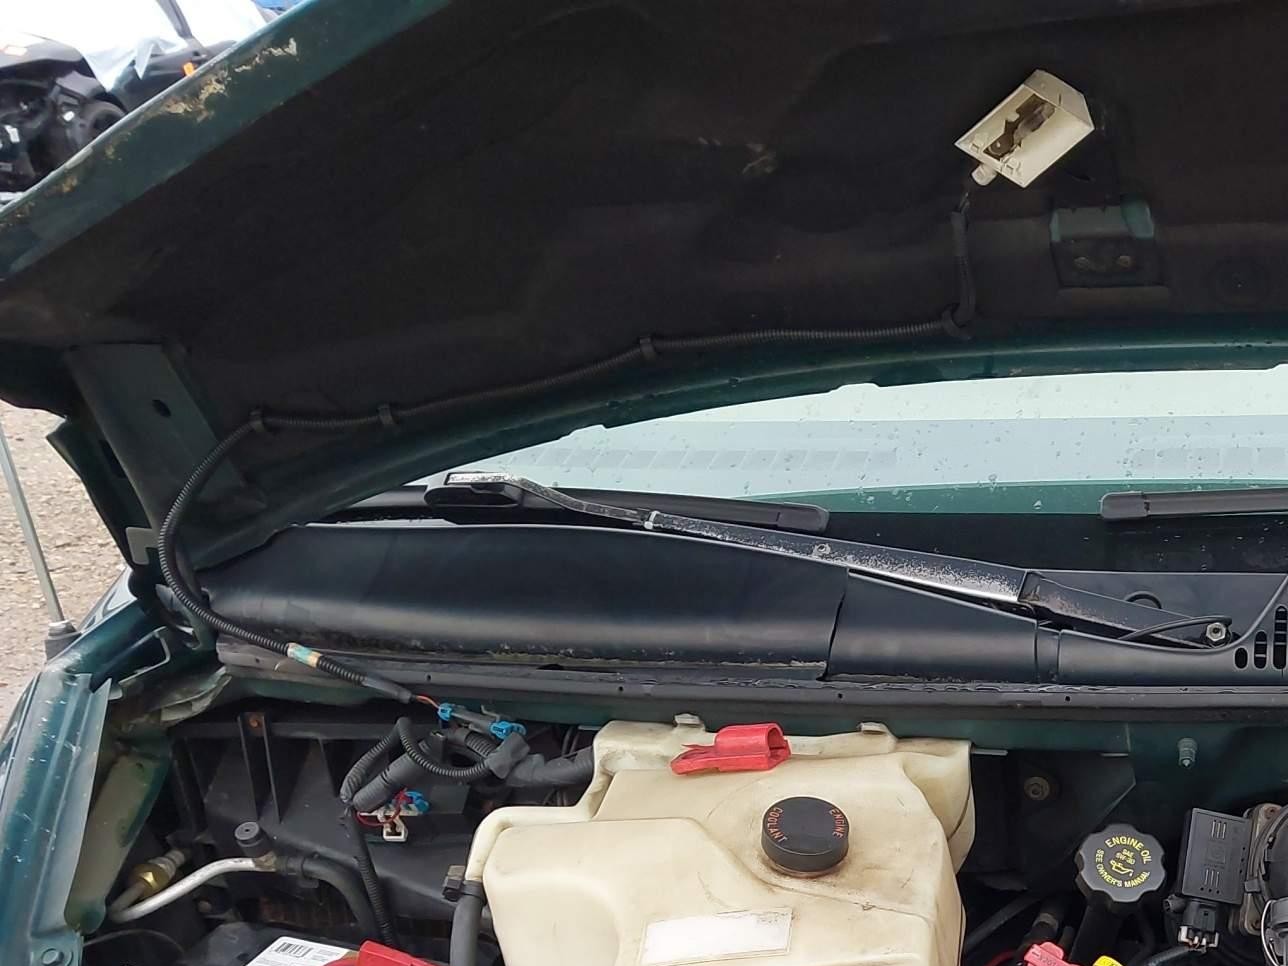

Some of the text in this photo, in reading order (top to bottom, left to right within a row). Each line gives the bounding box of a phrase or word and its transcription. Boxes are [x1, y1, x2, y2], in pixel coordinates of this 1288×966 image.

[767, 806, 788, 842] COOLANT
[829, 809, 845, 839] ENGINE
[1105, 836, 1152, 864] ENGINE OIL
[1095, 849, 1104, 863] SEE
[1124, 871, 1151, 888] MANUAL
